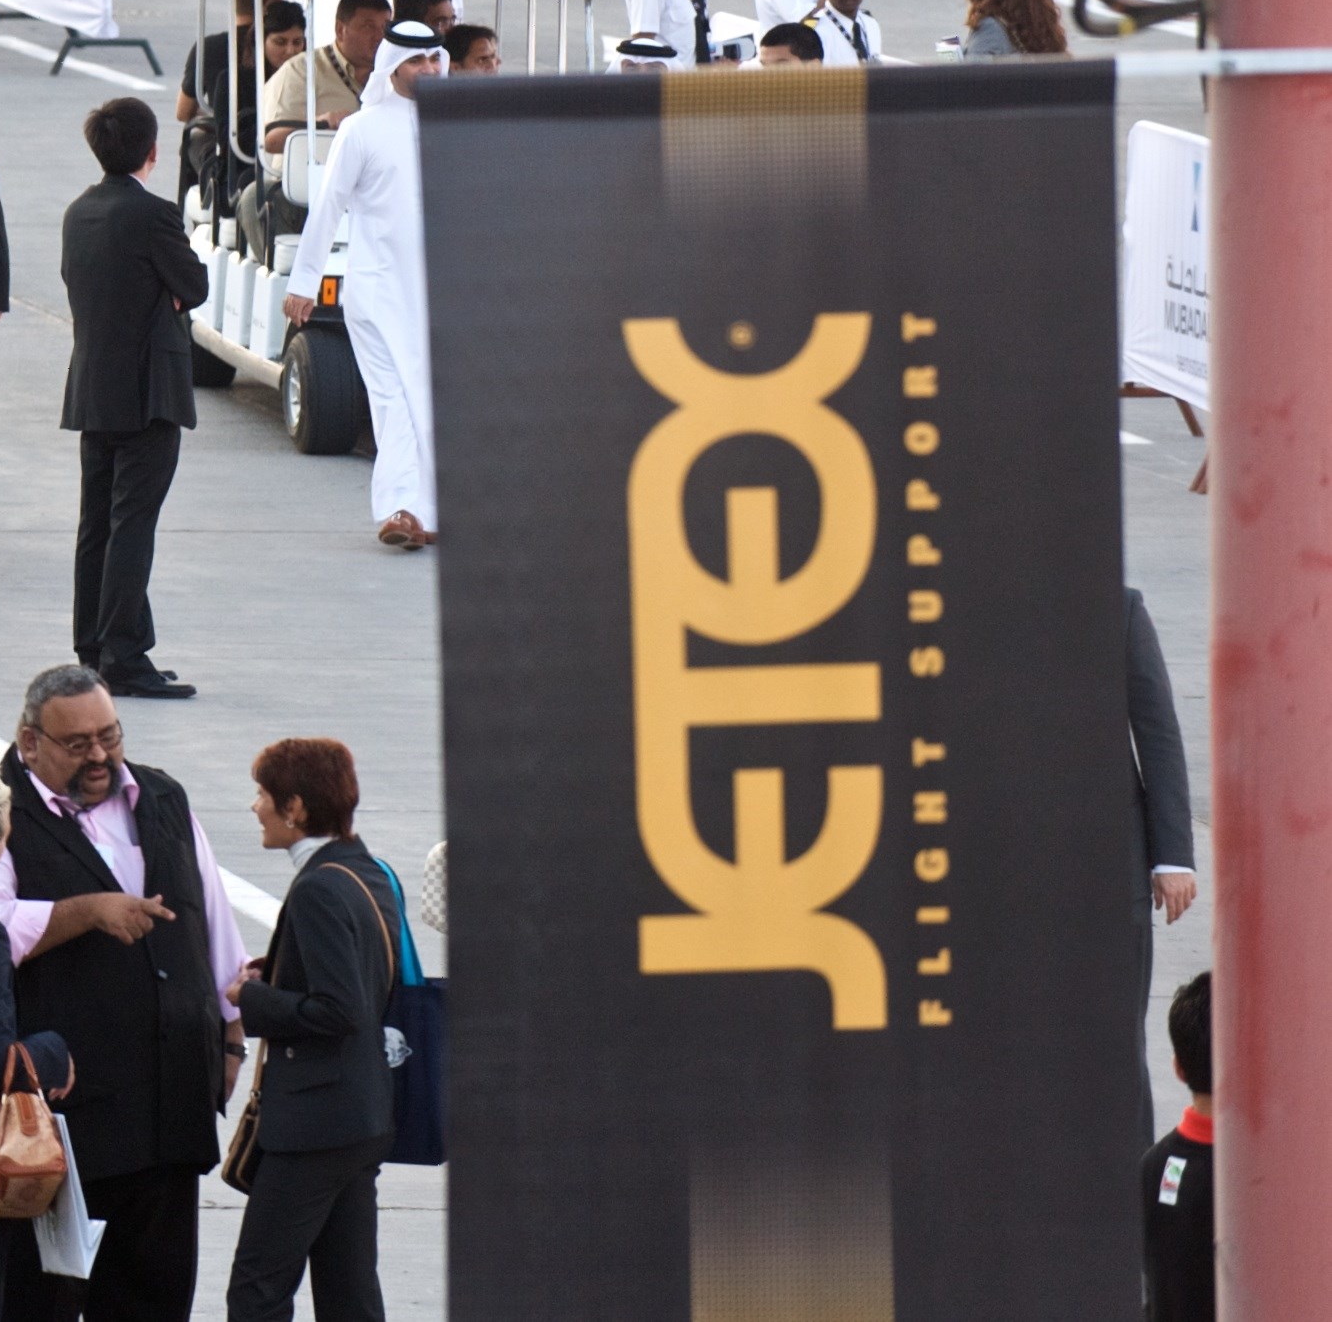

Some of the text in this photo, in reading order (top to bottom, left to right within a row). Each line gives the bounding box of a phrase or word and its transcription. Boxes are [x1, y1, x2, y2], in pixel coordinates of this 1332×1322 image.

[622, 312, 888, 1030] JETEX
[901, 312, 952, 1026] FLIGHT SUPPORT
[1164, 298, 1211, 342] MUBADA
